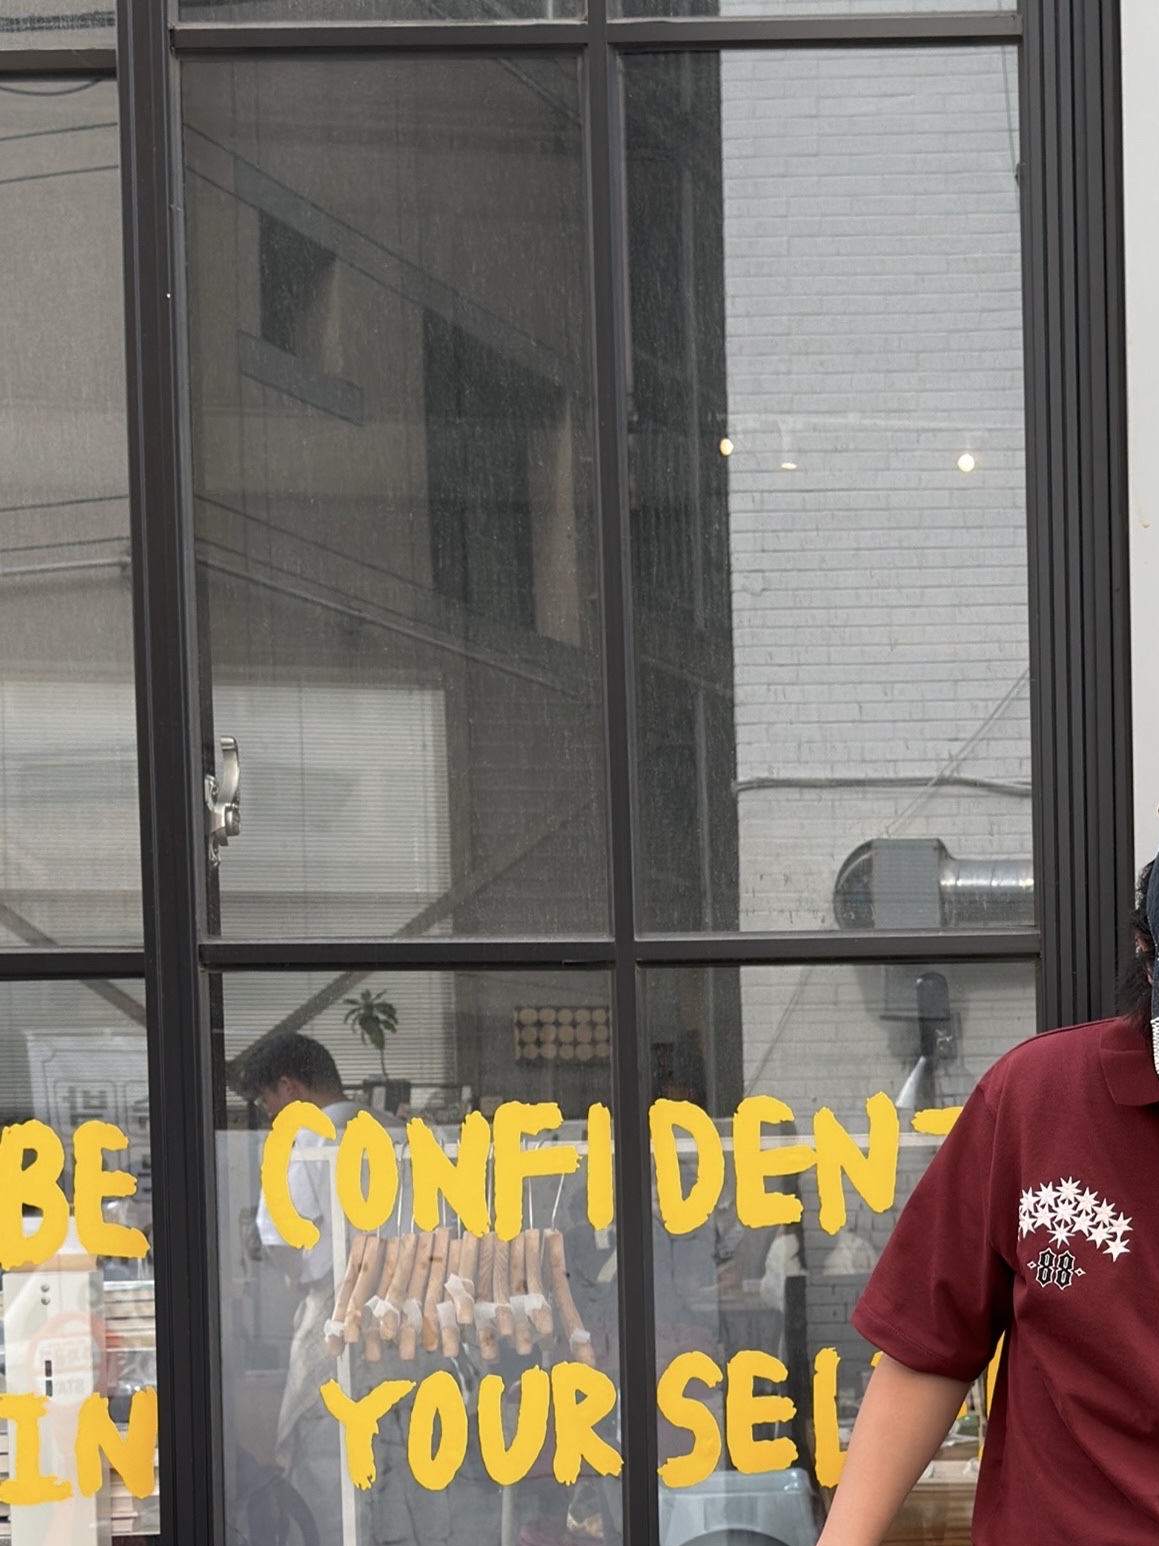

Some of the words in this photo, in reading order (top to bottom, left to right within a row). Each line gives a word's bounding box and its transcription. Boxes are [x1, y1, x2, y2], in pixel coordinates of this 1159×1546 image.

[0, 1118, 149, 1270] BE
[260, 1093, 963, 1249] CONFIDEN
[1035, 1246, 1076, 1291] 88
[0, 1387, 158, 1505] IN
[320, 1347, 969, 1490] YOURSEL
